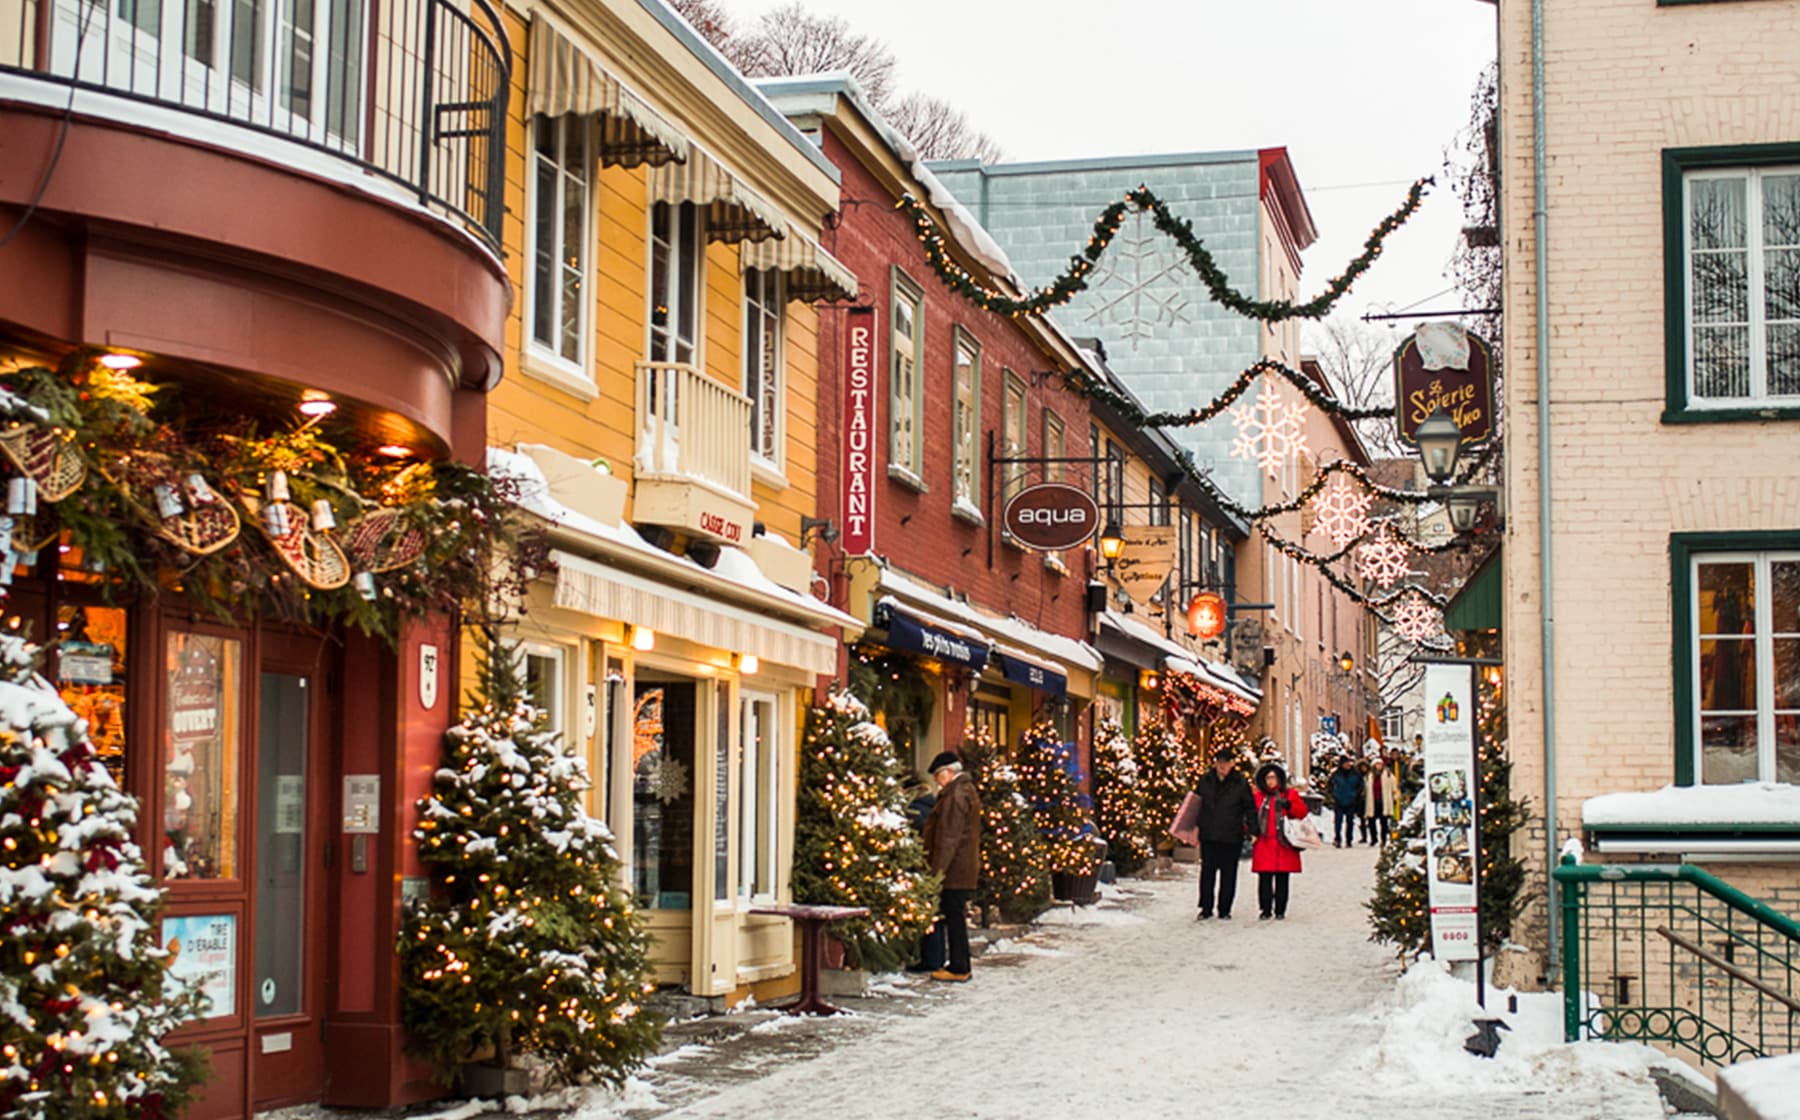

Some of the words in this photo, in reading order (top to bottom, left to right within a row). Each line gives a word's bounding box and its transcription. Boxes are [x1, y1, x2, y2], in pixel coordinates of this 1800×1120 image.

[848, 327, 869, 536] RESTAURANT
[701, 511, 725, 536] CASSE
[725, 522, 742, 542] COU
[1018, 508, 1086, 527] aqua
[210, 922, 228, 937] TIRE
